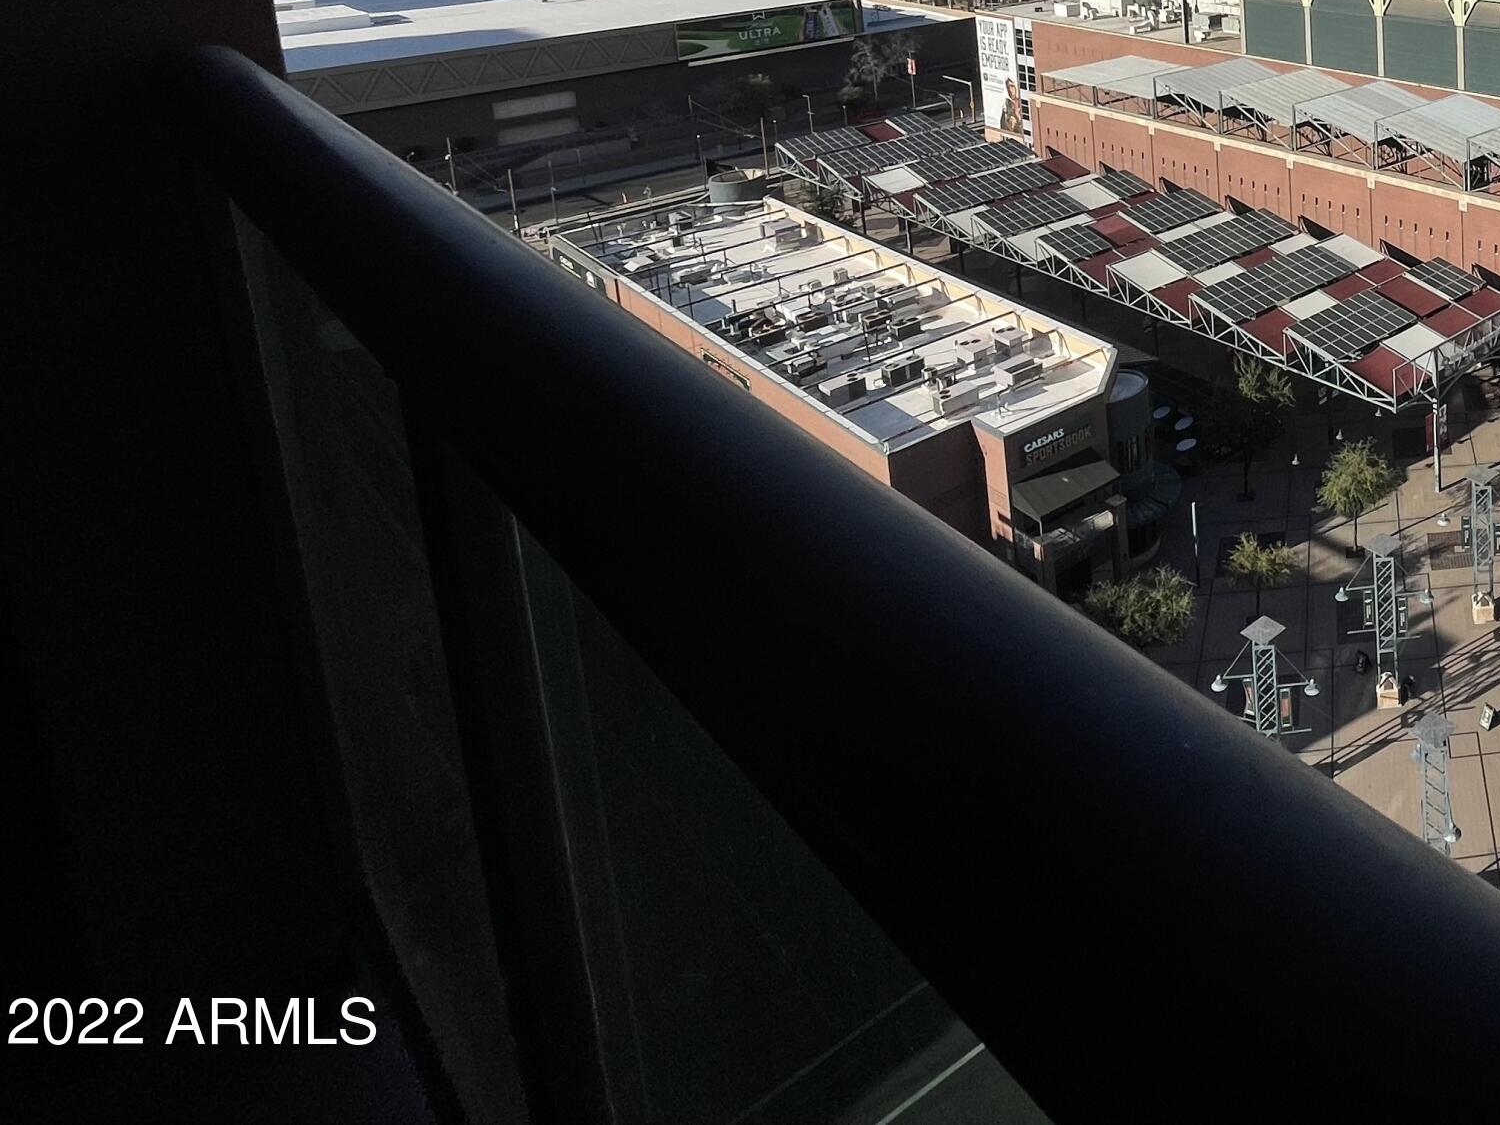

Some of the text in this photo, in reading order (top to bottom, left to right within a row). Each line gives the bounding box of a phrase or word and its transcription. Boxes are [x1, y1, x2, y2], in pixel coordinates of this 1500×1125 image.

[738, 27, 782, 41] ULTRA
[978, 19, 1007, 38] YOUR APP
[980, 36, 986, 51] IS
[1023, 428, 1065, 453] CAESARS
[1025, 425, 1092, 467] SPORTSBOOK
